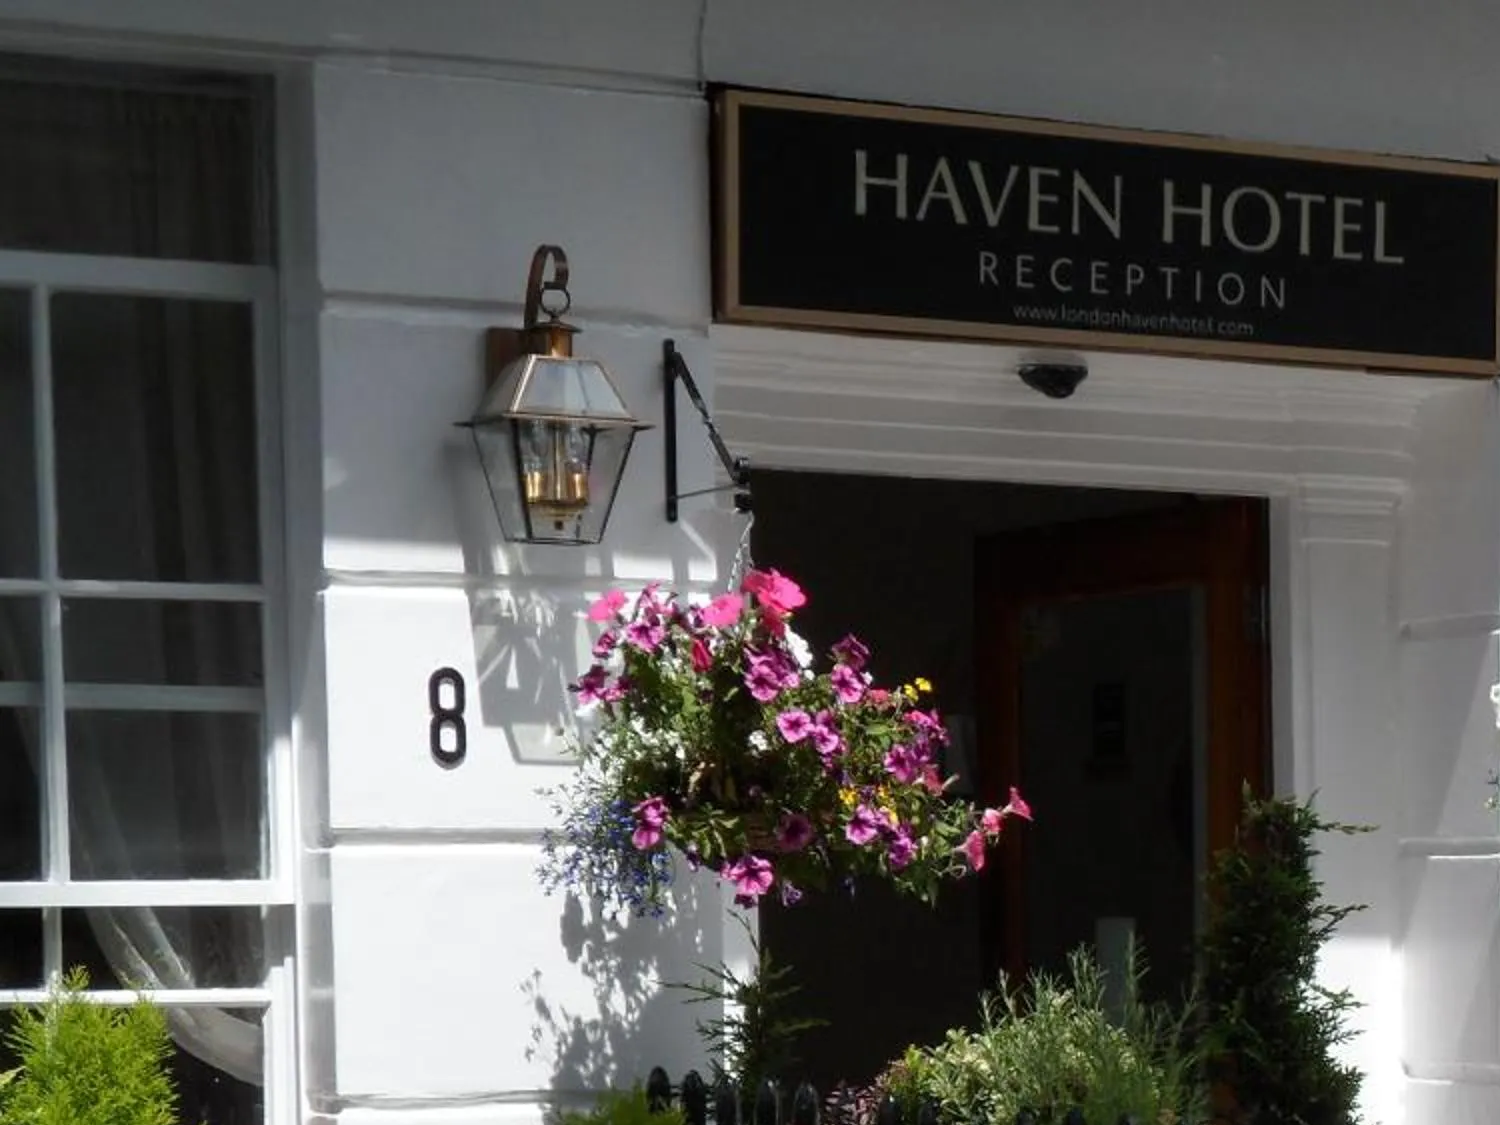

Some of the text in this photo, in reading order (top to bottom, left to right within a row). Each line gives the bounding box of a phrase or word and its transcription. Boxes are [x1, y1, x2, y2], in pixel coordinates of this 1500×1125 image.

[854, 149, 1405, 264] HAVEN HOTEL
[979, 251, 1286, 309] RECEPTION
[1012, 302, 1255, 336] www.londonhavenhotel.com
[428, 666, 467, 770] 8
